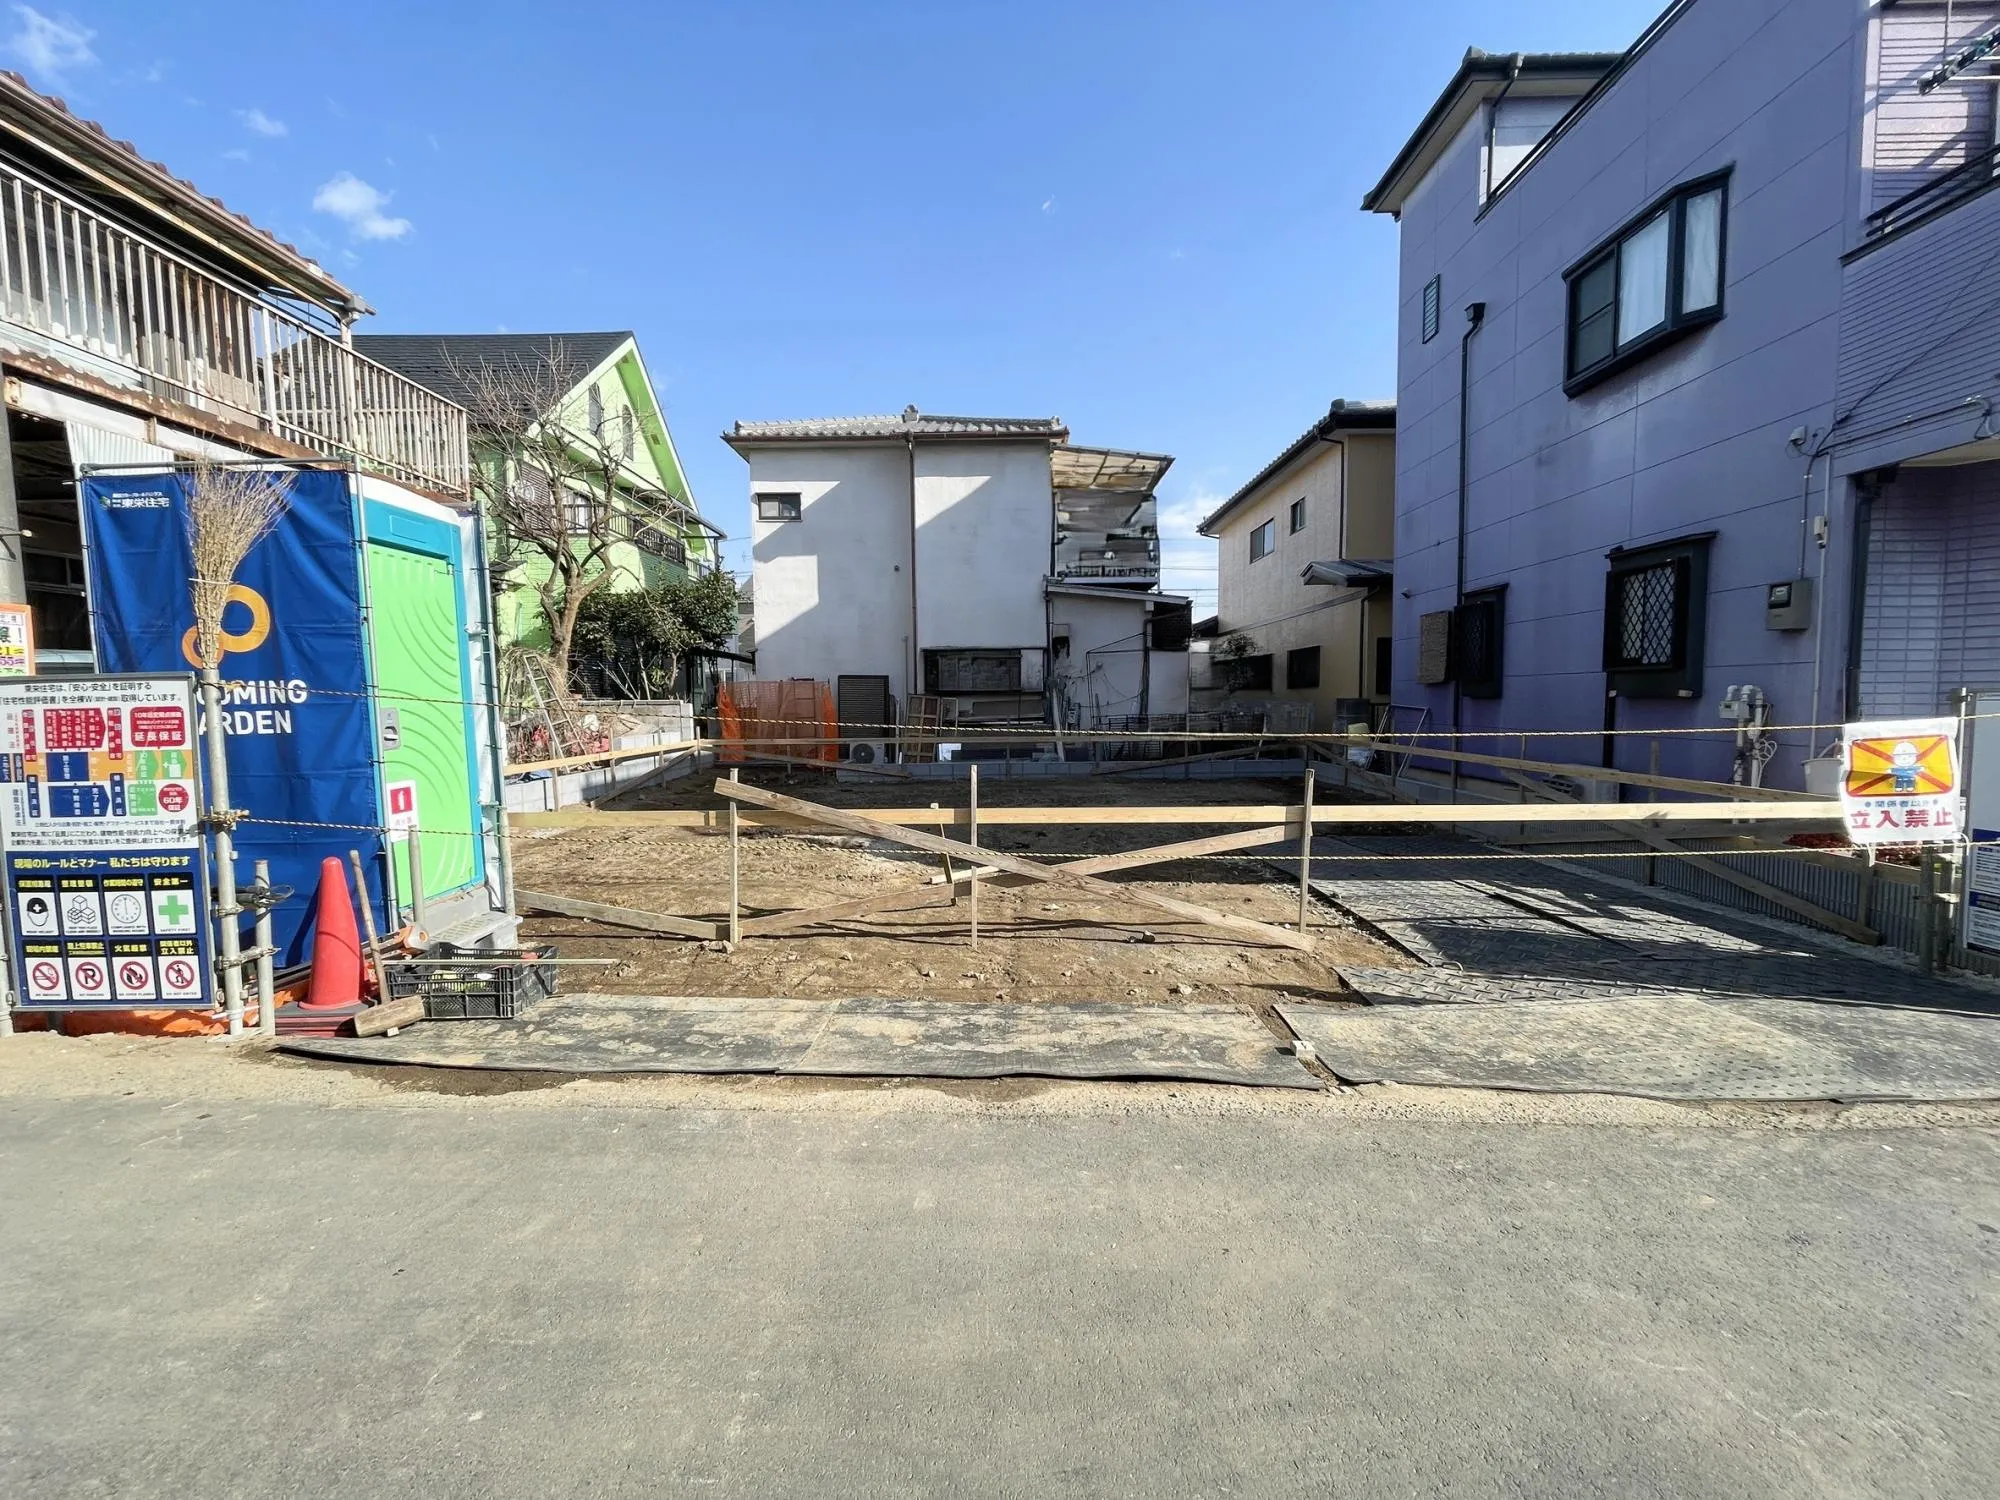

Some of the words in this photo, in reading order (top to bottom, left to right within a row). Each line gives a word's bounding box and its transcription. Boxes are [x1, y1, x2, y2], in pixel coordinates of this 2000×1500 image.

[134, 731, 182, 741] 延長保証
[1851, 807, 1953, 829] 立入禁止
[14, 858, 107, 868] 現場のルールとマナー
[110, 856, 190, 868] 私たちは守ります
[153, 877, 188, 886] 安全第一
[161, 947, 194, 955] 立入禁止
